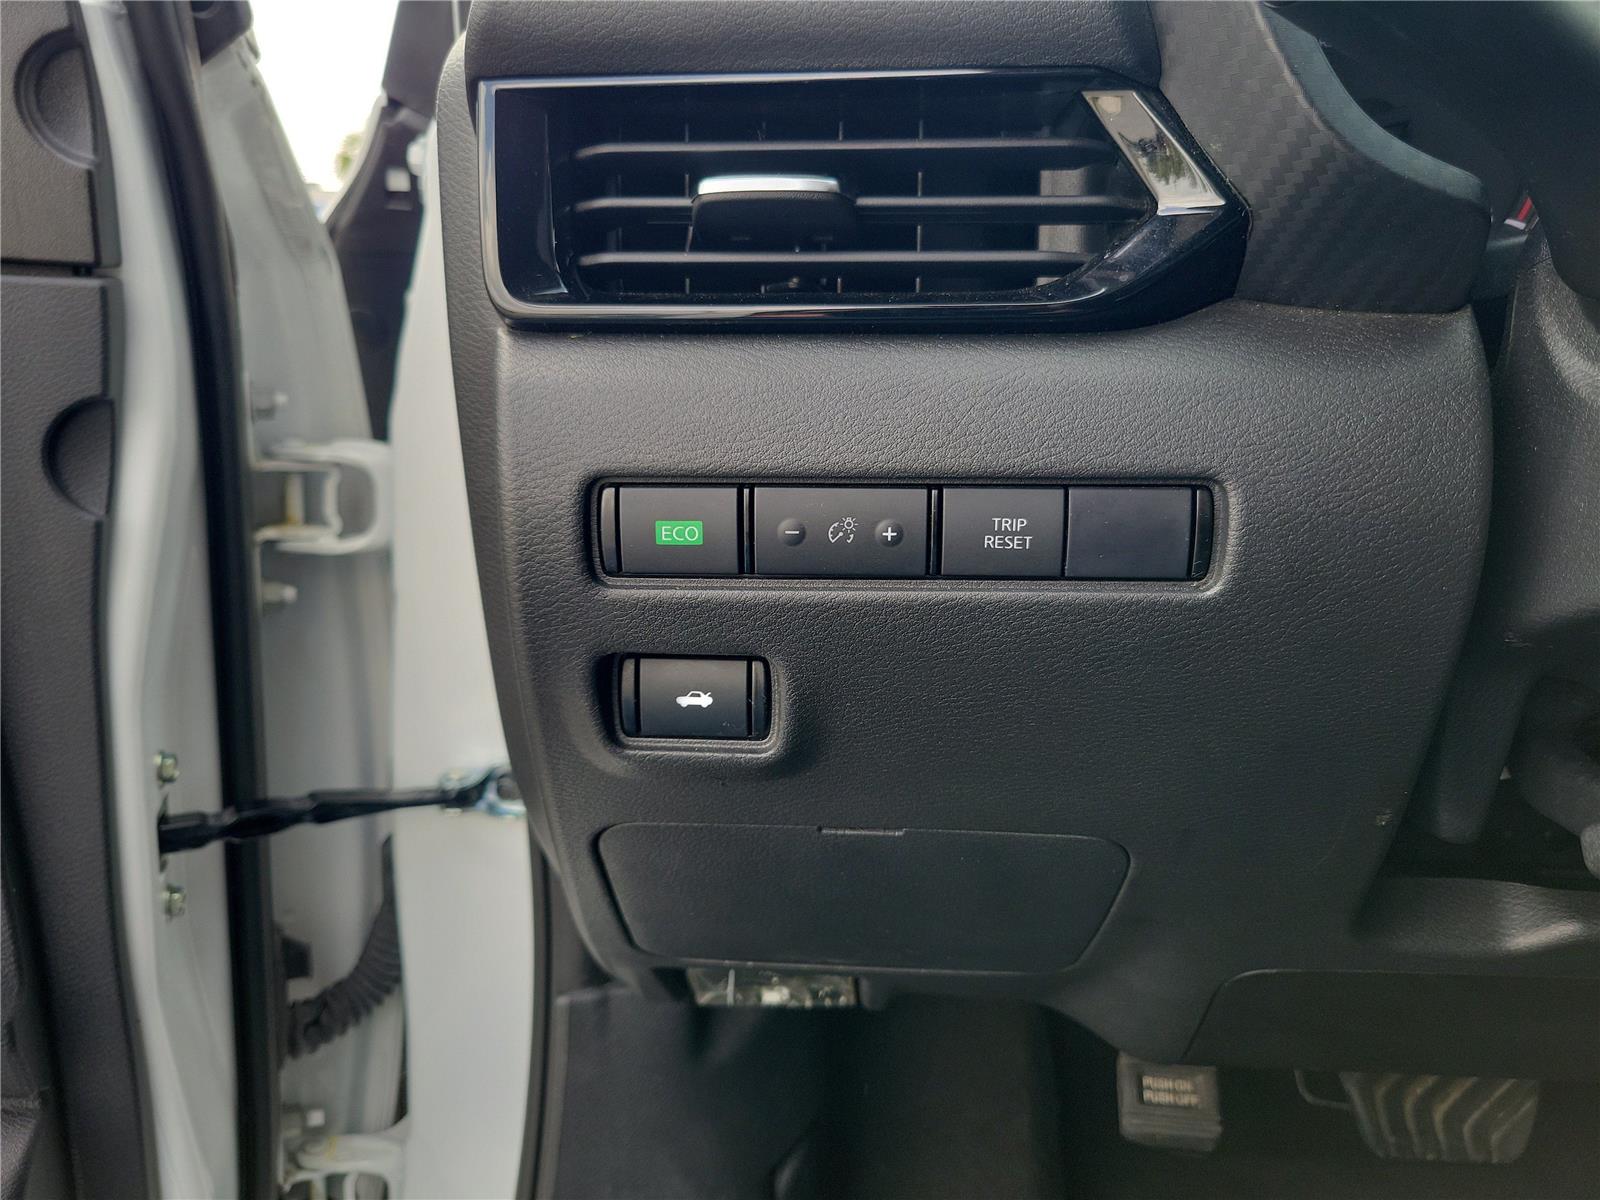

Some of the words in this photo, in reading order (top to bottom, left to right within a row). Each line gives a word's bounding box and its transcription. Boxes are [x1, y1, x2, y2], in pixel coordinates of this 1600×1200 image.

[991, 517, 1027, 531] TRIP
[661, 526, 699, 541] ECO
[984, 535, 1033, 549] RESET
[1142, 1075, 1174, 1090] PUSH
[1142, 1088, 1175, 1105] PUSH
